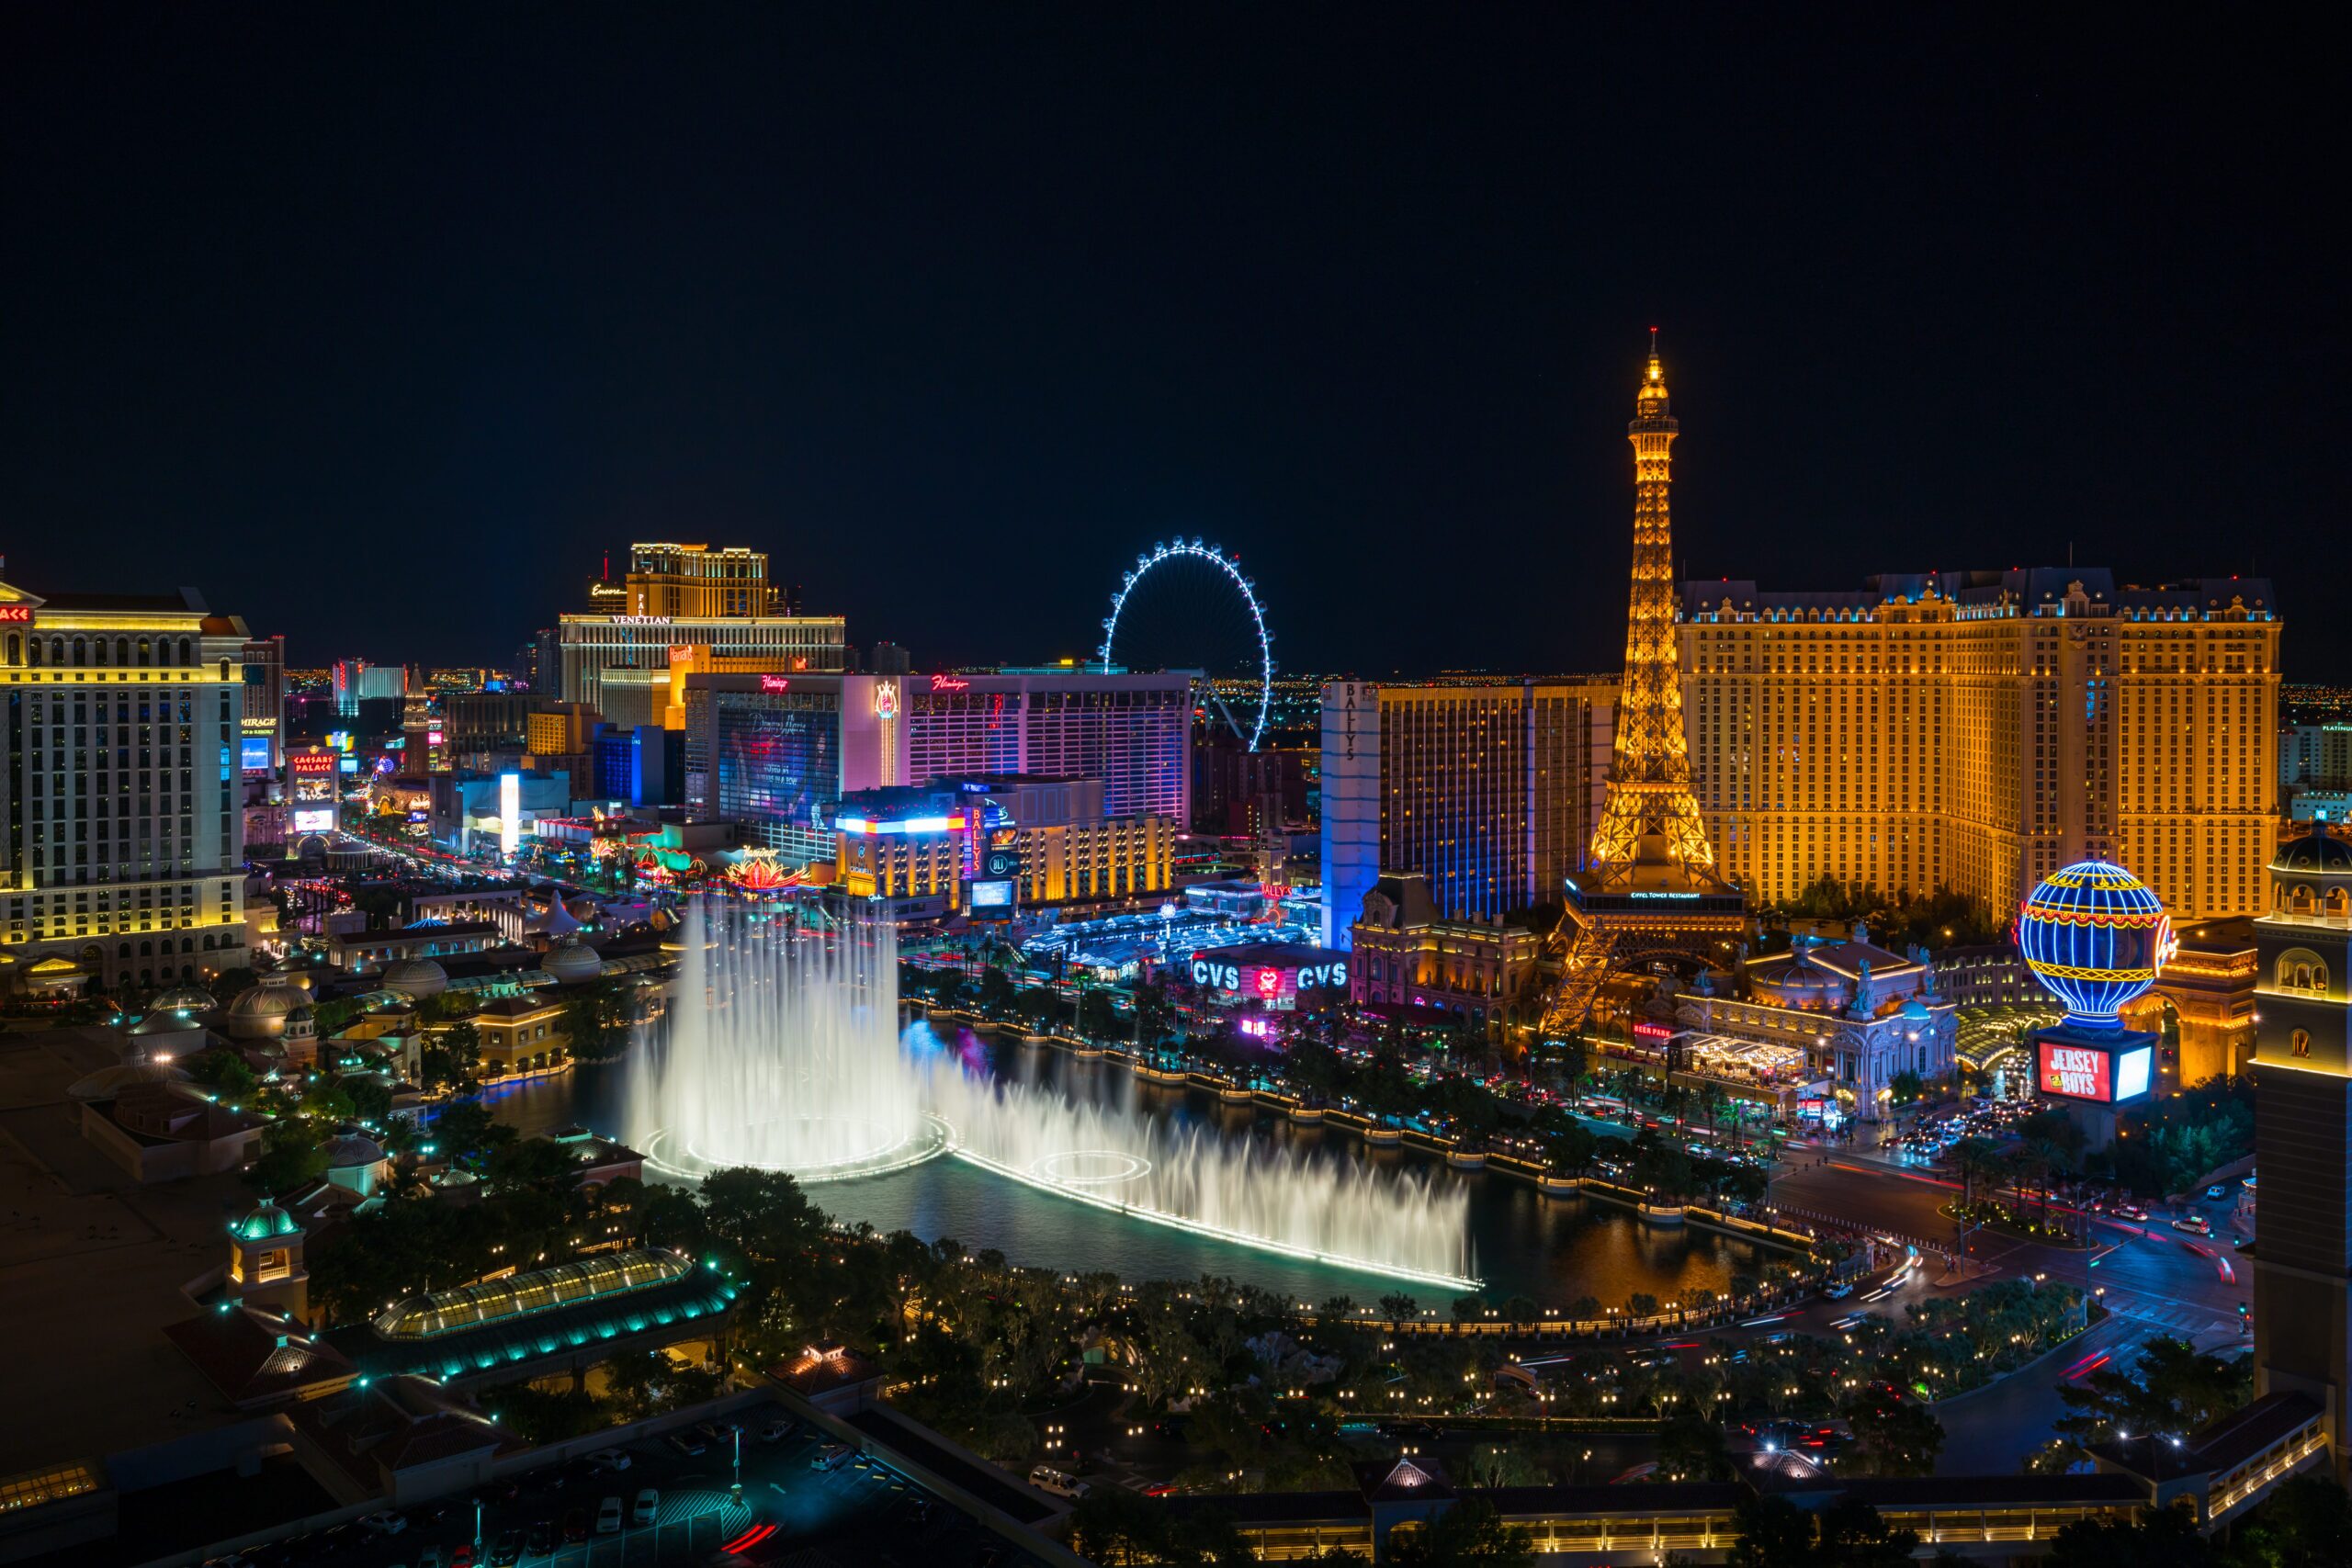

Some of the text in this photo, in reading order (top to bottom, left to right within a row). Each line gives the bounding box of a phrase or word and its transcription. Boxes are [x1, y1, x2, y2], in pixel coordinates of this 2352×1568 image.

[592, 584, 628, 596] Encore
[612, 615, 671, 625] VENETIAN
[763, 675, 787, 691] Flamingo
[932, 675, 969, 691] Flamingo
[294, 756, 333, 764] CAESARS
[296, 763, 332, 772] PALACE
[993, 858, 1004, 870] BLT
[1193, 961, 1238, 990] CVS
[1297, 963, 1347, 991] CVS
[1634, 1024, 1670, 1037] BEER PARK
[2050, 1048, 2099, 1074] JERSEY
[2060, 1071, 2097, 1096] BOYS
